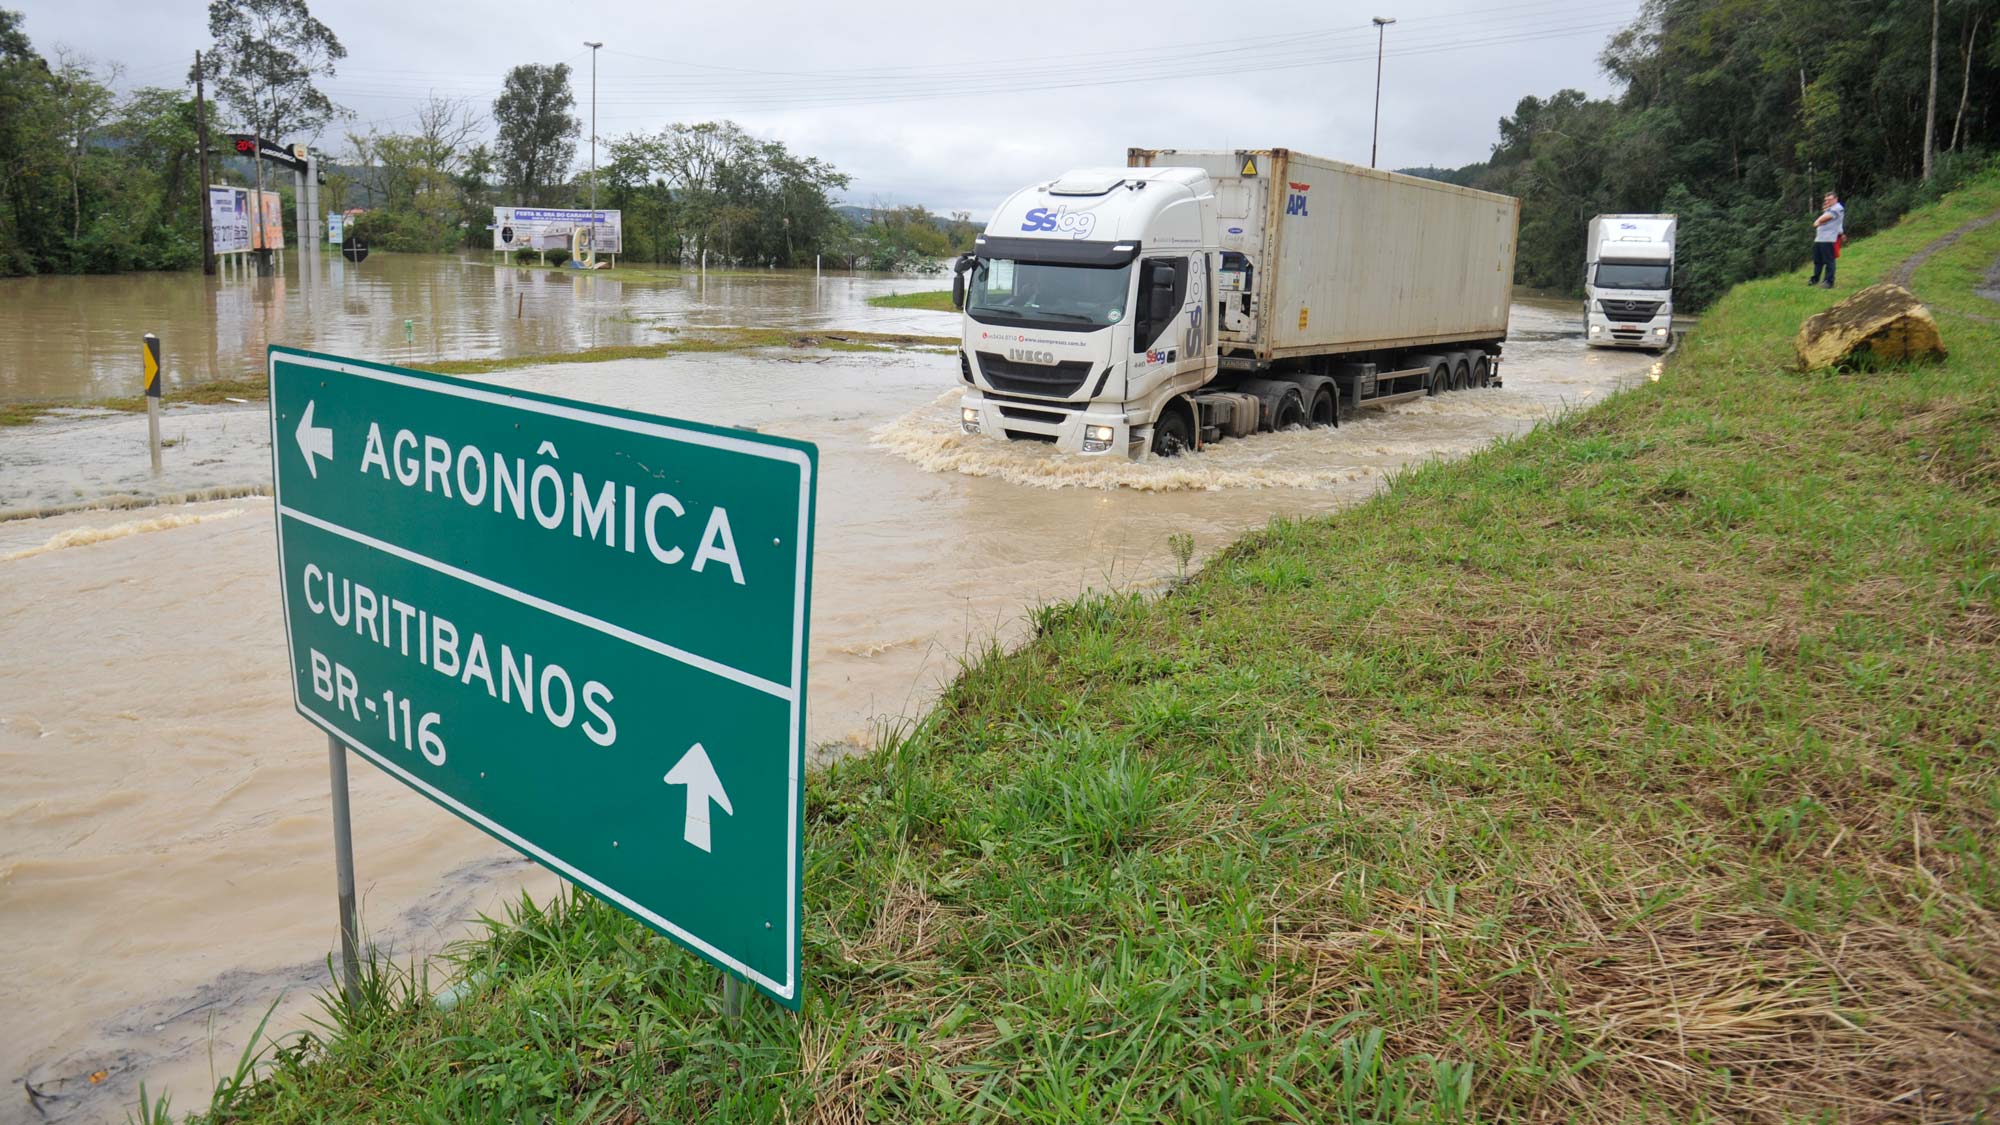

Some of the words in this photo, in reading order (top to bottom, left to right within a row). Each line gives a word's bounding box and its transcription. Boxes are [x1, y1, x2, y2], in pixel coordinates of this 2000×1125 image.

[1021, 204, 1096, 240] Sslog
[1286, 194, 1308, 216] APL
[1010, 348, 1054, 363] IVECO
[360, 422, 746, 585] AGRONÔMICA
[303, 563, 617, 747] CURITIBANOS
[310, 648, 447, 767] BR-116
